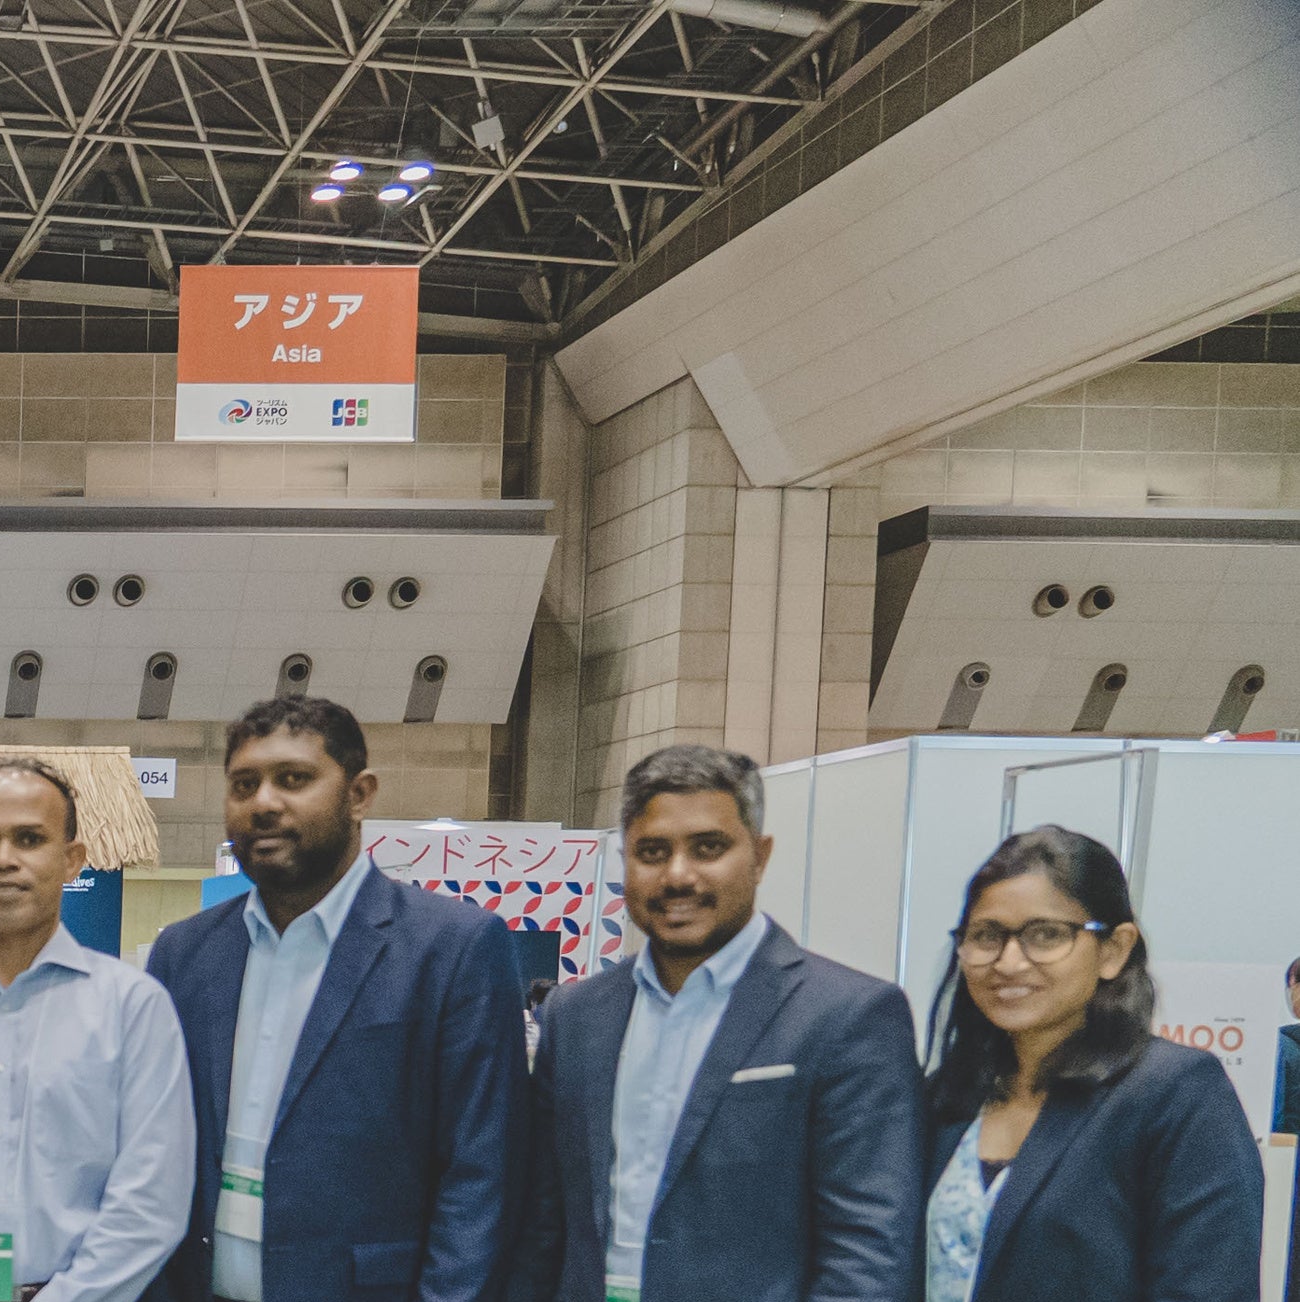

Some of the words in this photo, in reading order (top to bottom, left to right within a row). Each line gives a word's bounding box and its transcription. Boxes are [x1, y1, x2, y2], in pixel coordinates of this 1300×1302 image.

[233, 292, 364, 330] アジア
[271, 344, 322, 363] Asia
[256, 407, 288, 418] EXPO
[256, 418, 288, 426] ジャパン
[137, 771, 169, 784] 054
[366, 834, 599, 876] インドネシア
[1159, 1024, 1244, 1052] MOO
